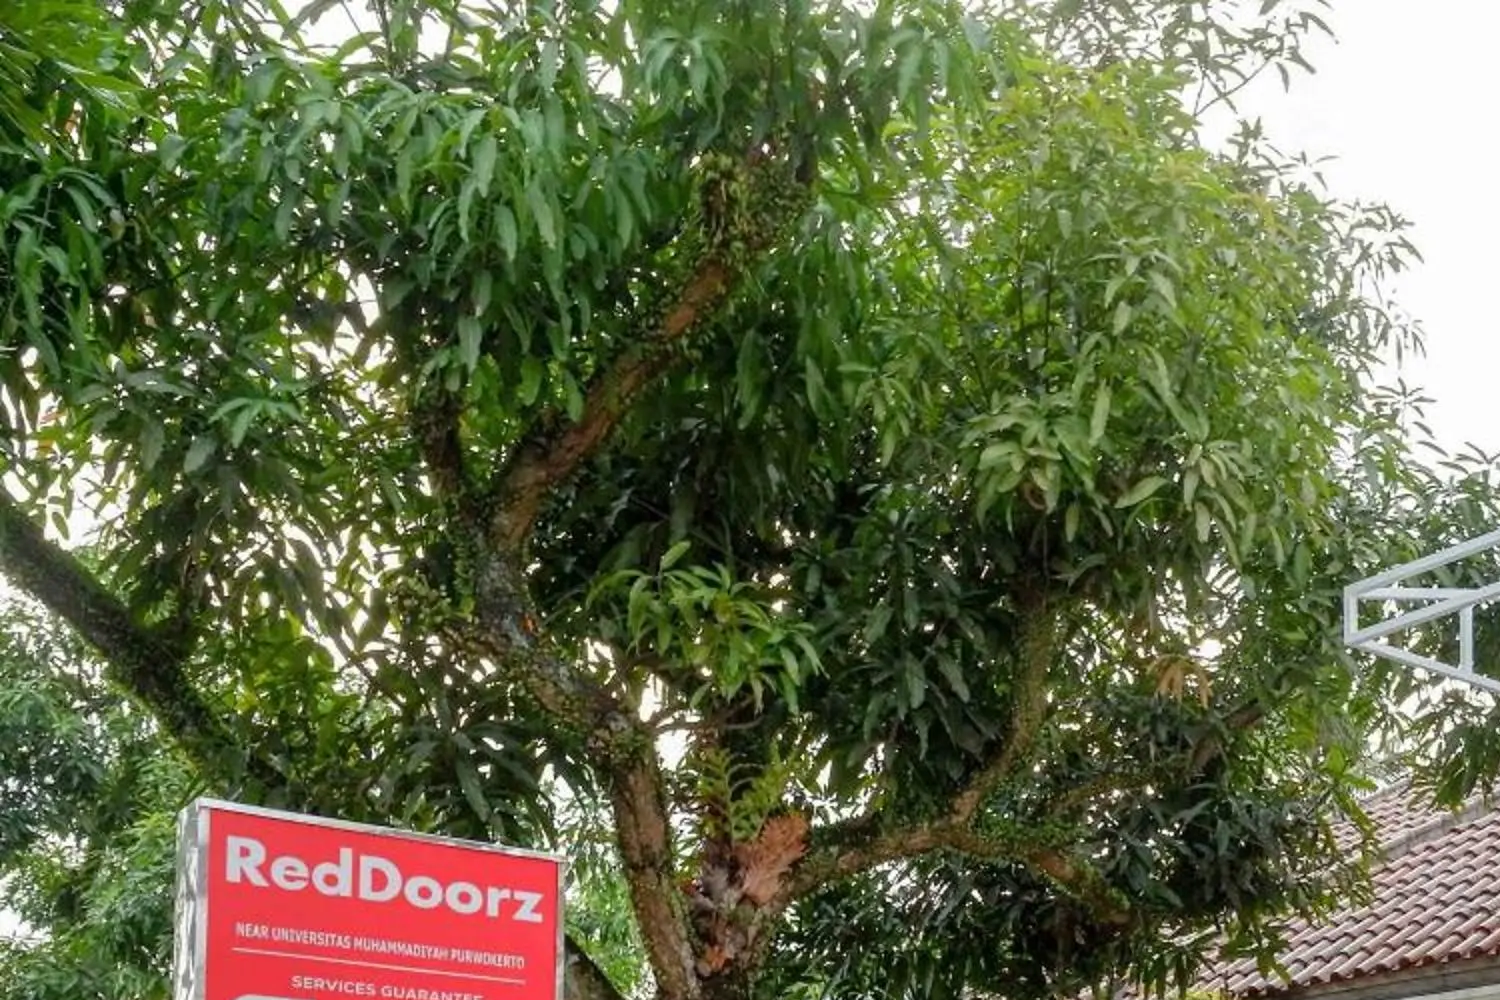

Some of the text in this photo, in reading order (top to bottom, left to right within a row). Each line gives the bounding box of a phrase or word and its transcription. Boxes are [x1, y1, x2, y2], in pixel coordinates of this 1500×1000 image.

[225, 835, 544, 924] RedDoorz
[235, 921, 270, 940] NEAR
[272, 927, 351, 949] UNIVERSITAS
[290, 974, 377, 997] SERVICES
